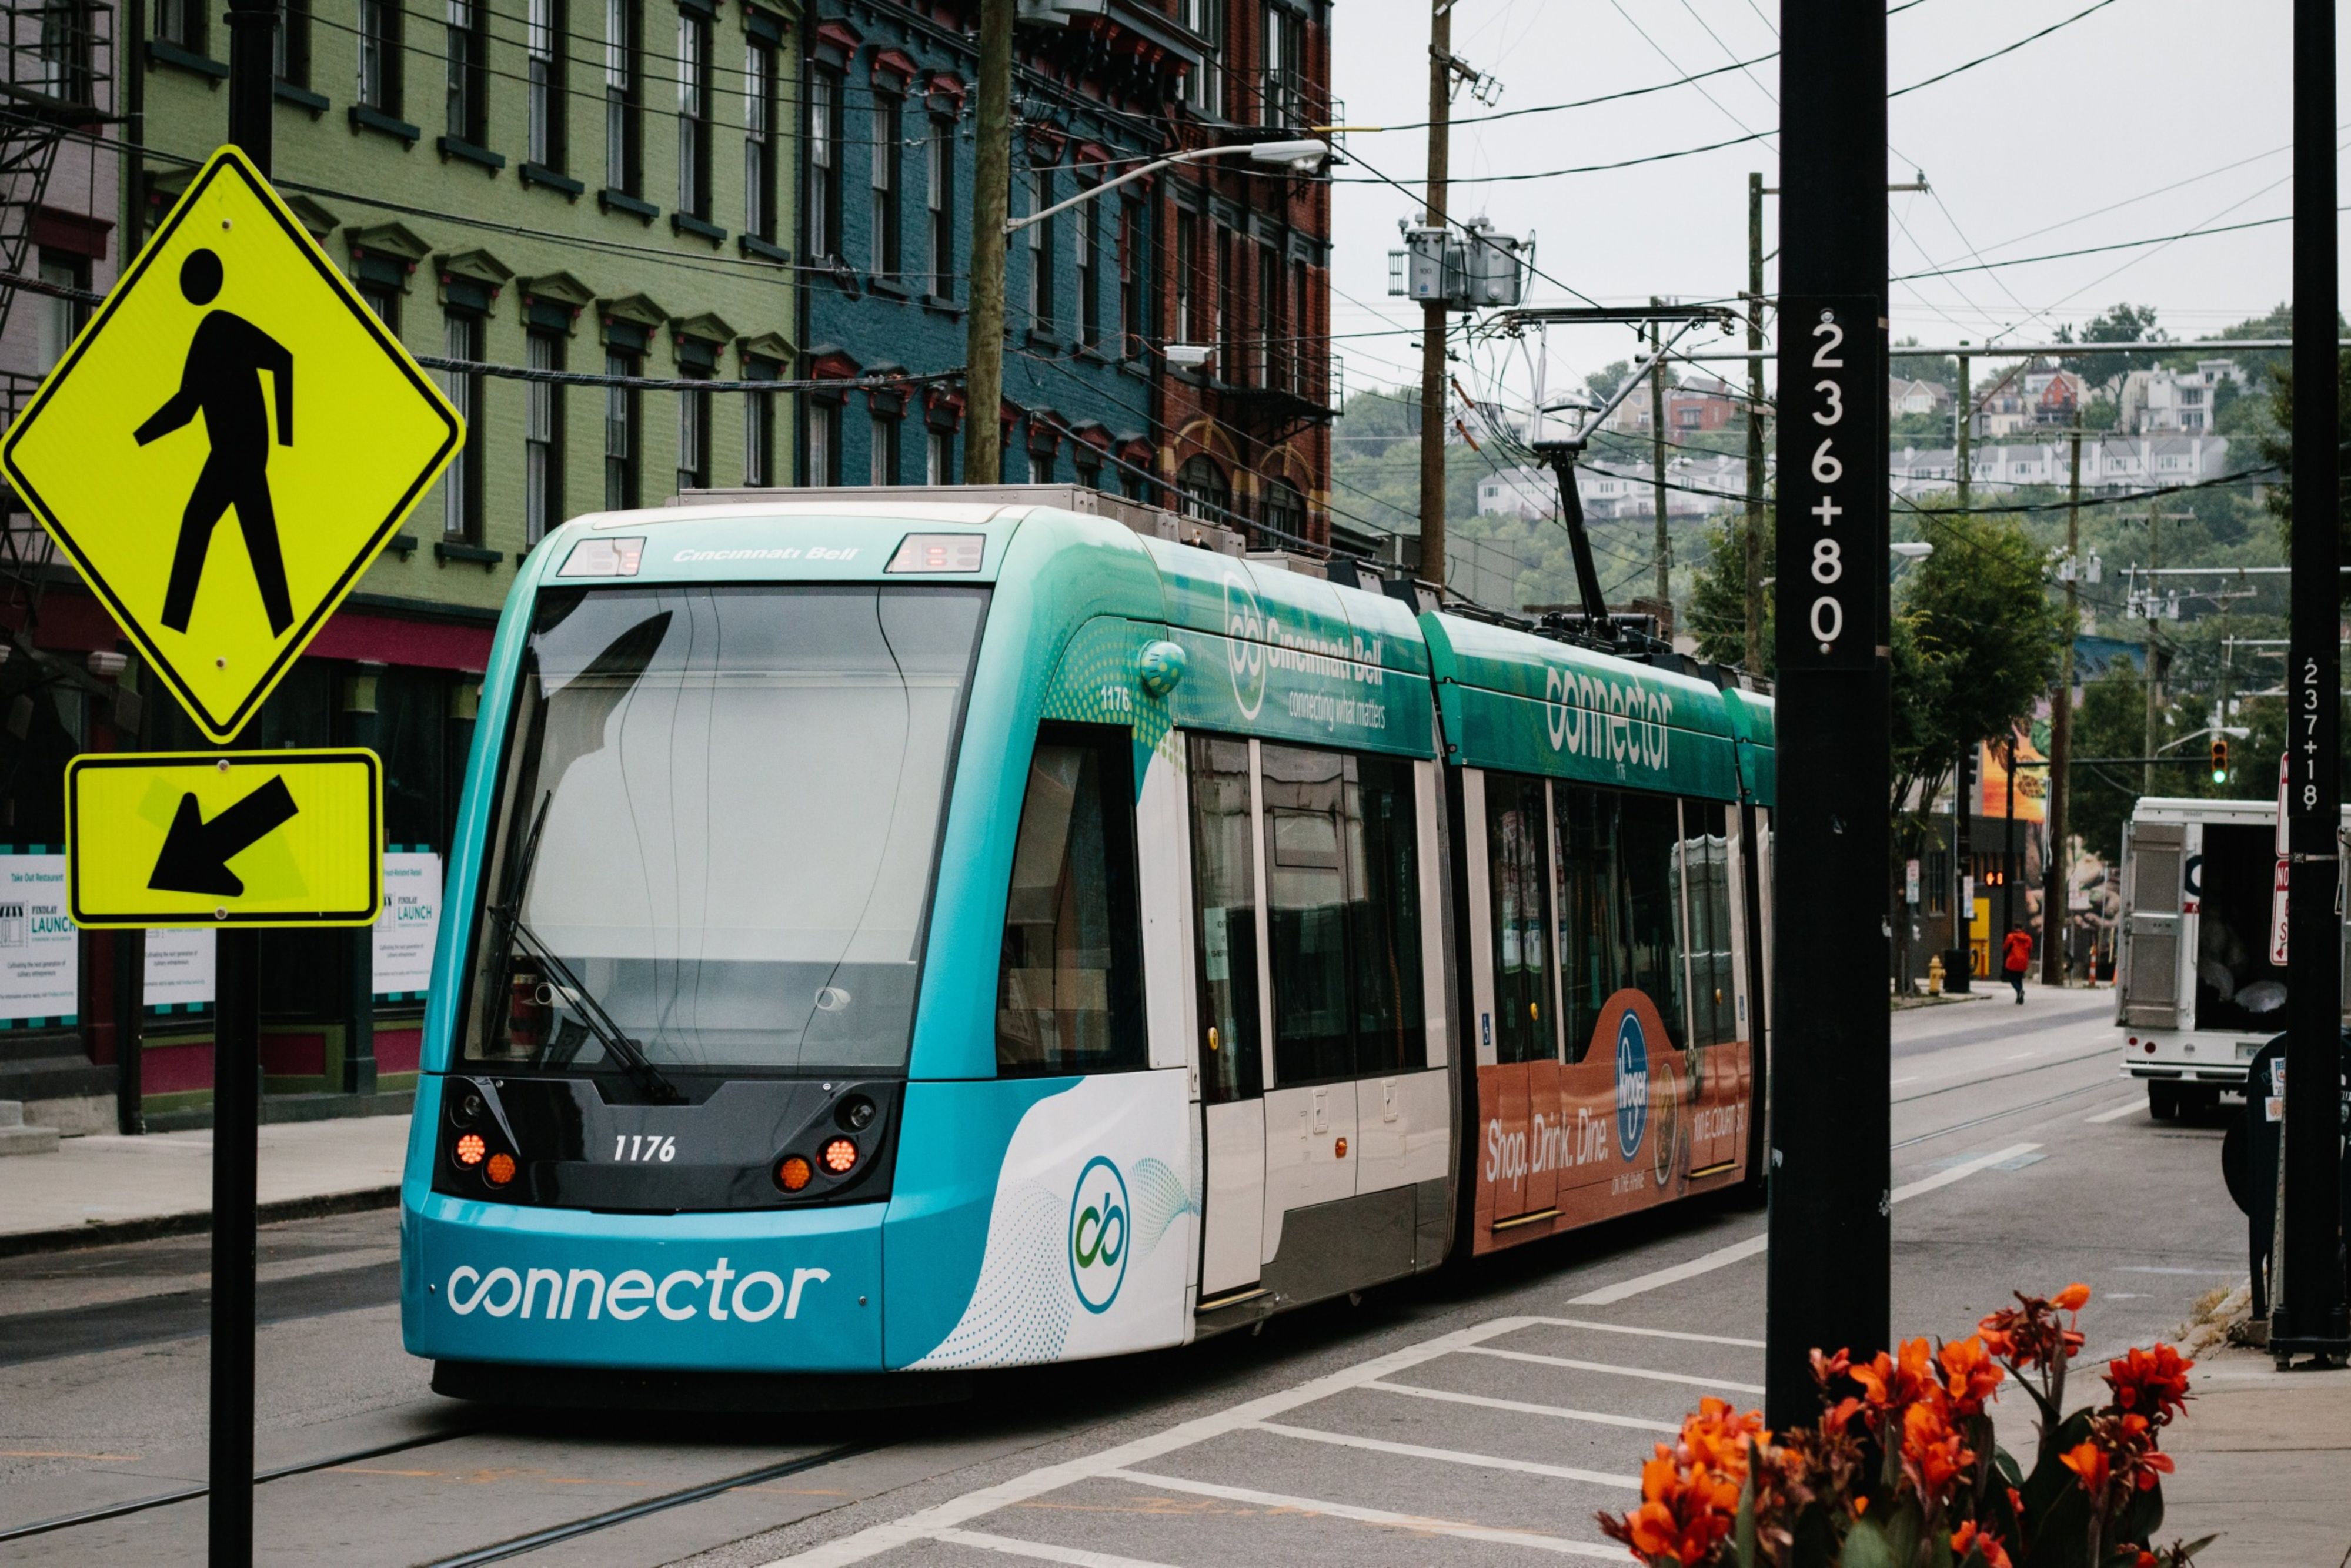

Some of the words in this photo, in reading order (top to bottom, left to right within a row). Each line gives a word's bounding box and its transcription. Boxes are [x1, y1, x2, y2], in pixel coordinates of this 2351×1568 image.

[1811, 322, 1843, 643] 236+80
[673, 547, 802, 562] Cincinnati
[804, 547, 859, 560] Bell
[1267, 617, 1351, 679] Cincinnati
[1353, 635, 1383, 685] Bell
[1101, 685, 1130, 712] 1176
[1289, 687, 1334, 732] connecting
[1335, 689, 1355, 725] what
[1356, 699, 1385, 729] matters
[1546, 666, 1673, 771] connector
[2303, 664, 2318, 805] 237+18
[11, 872, 23, 882] Take
[25, 872, 35, 882] Out
[36, 872, 64, 882] Restaurant
[31, 917, 76, 932] LAUNCH
[398, 905, 432, 920] LAUNCH
[1618, 1037, 1647, 1141] Kroger
[1712, 1105, 1735, 1138] COURT
[613, 1135, 676, 1162] 1176
[1486, 1118, 1528, 1192] Shop.
[1532, 1111, 1573, 1173] Drink.
[1577, 1107, 1608, 1165] Dine.
[446, 1256, 831, 1323] connector
